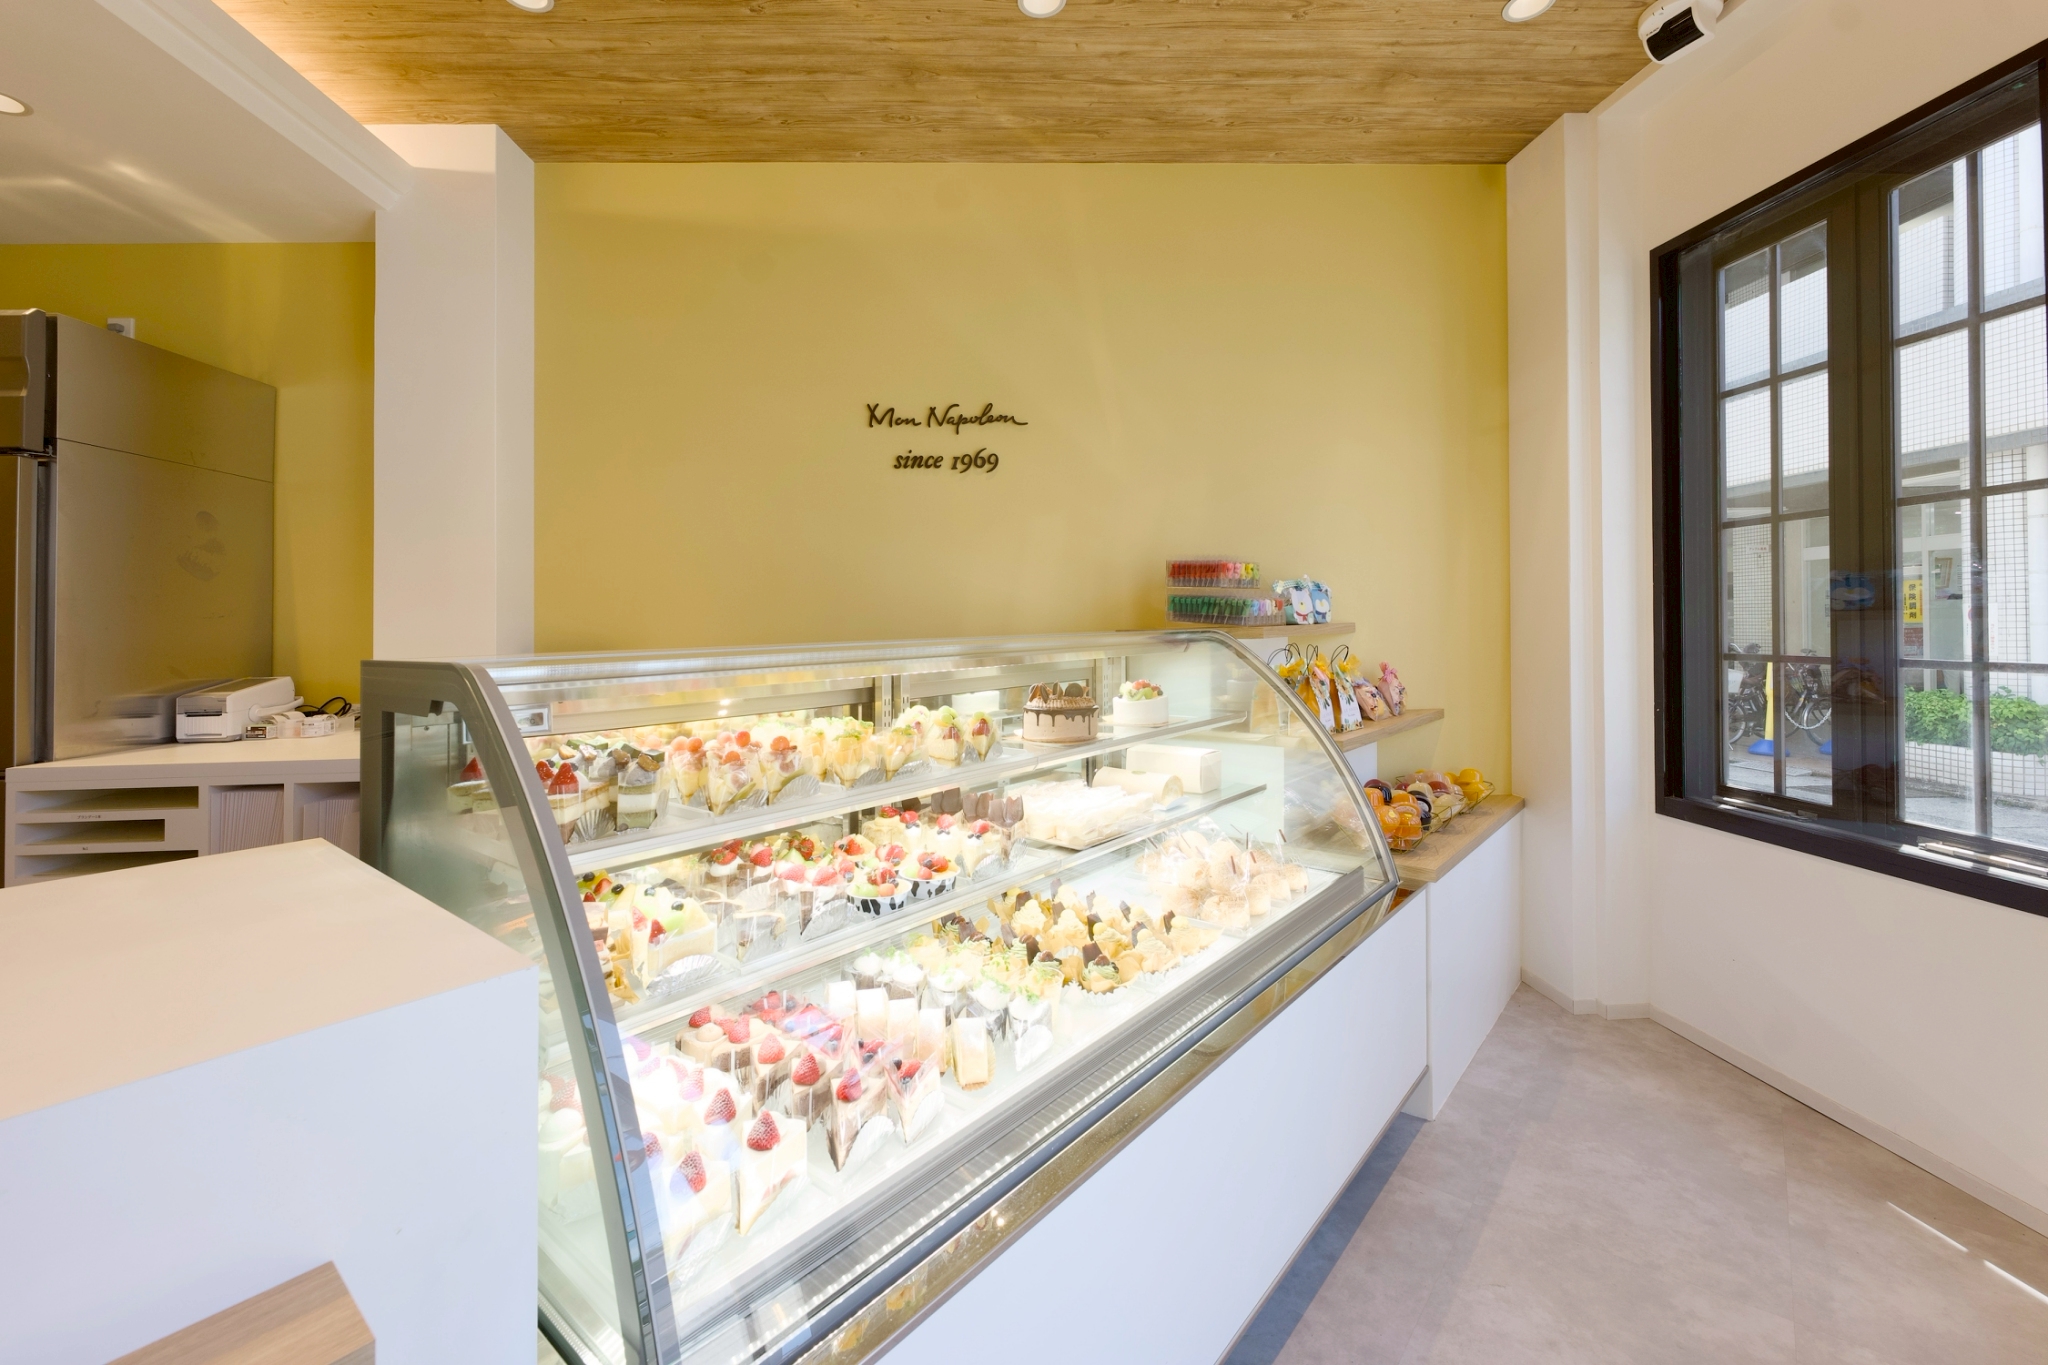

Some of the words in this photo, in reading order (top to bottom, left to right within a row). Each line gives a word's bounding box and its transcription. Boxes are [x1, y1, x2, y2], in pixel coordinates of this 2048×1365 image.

[867, 403, 922, 428] Mon
[927, 403, 1029, 435] Napoleon
[894, 450, 943, 469] since
[950, 448, 999, 474] 1969
[1908, 583, 1917, 619] 保険調剤
